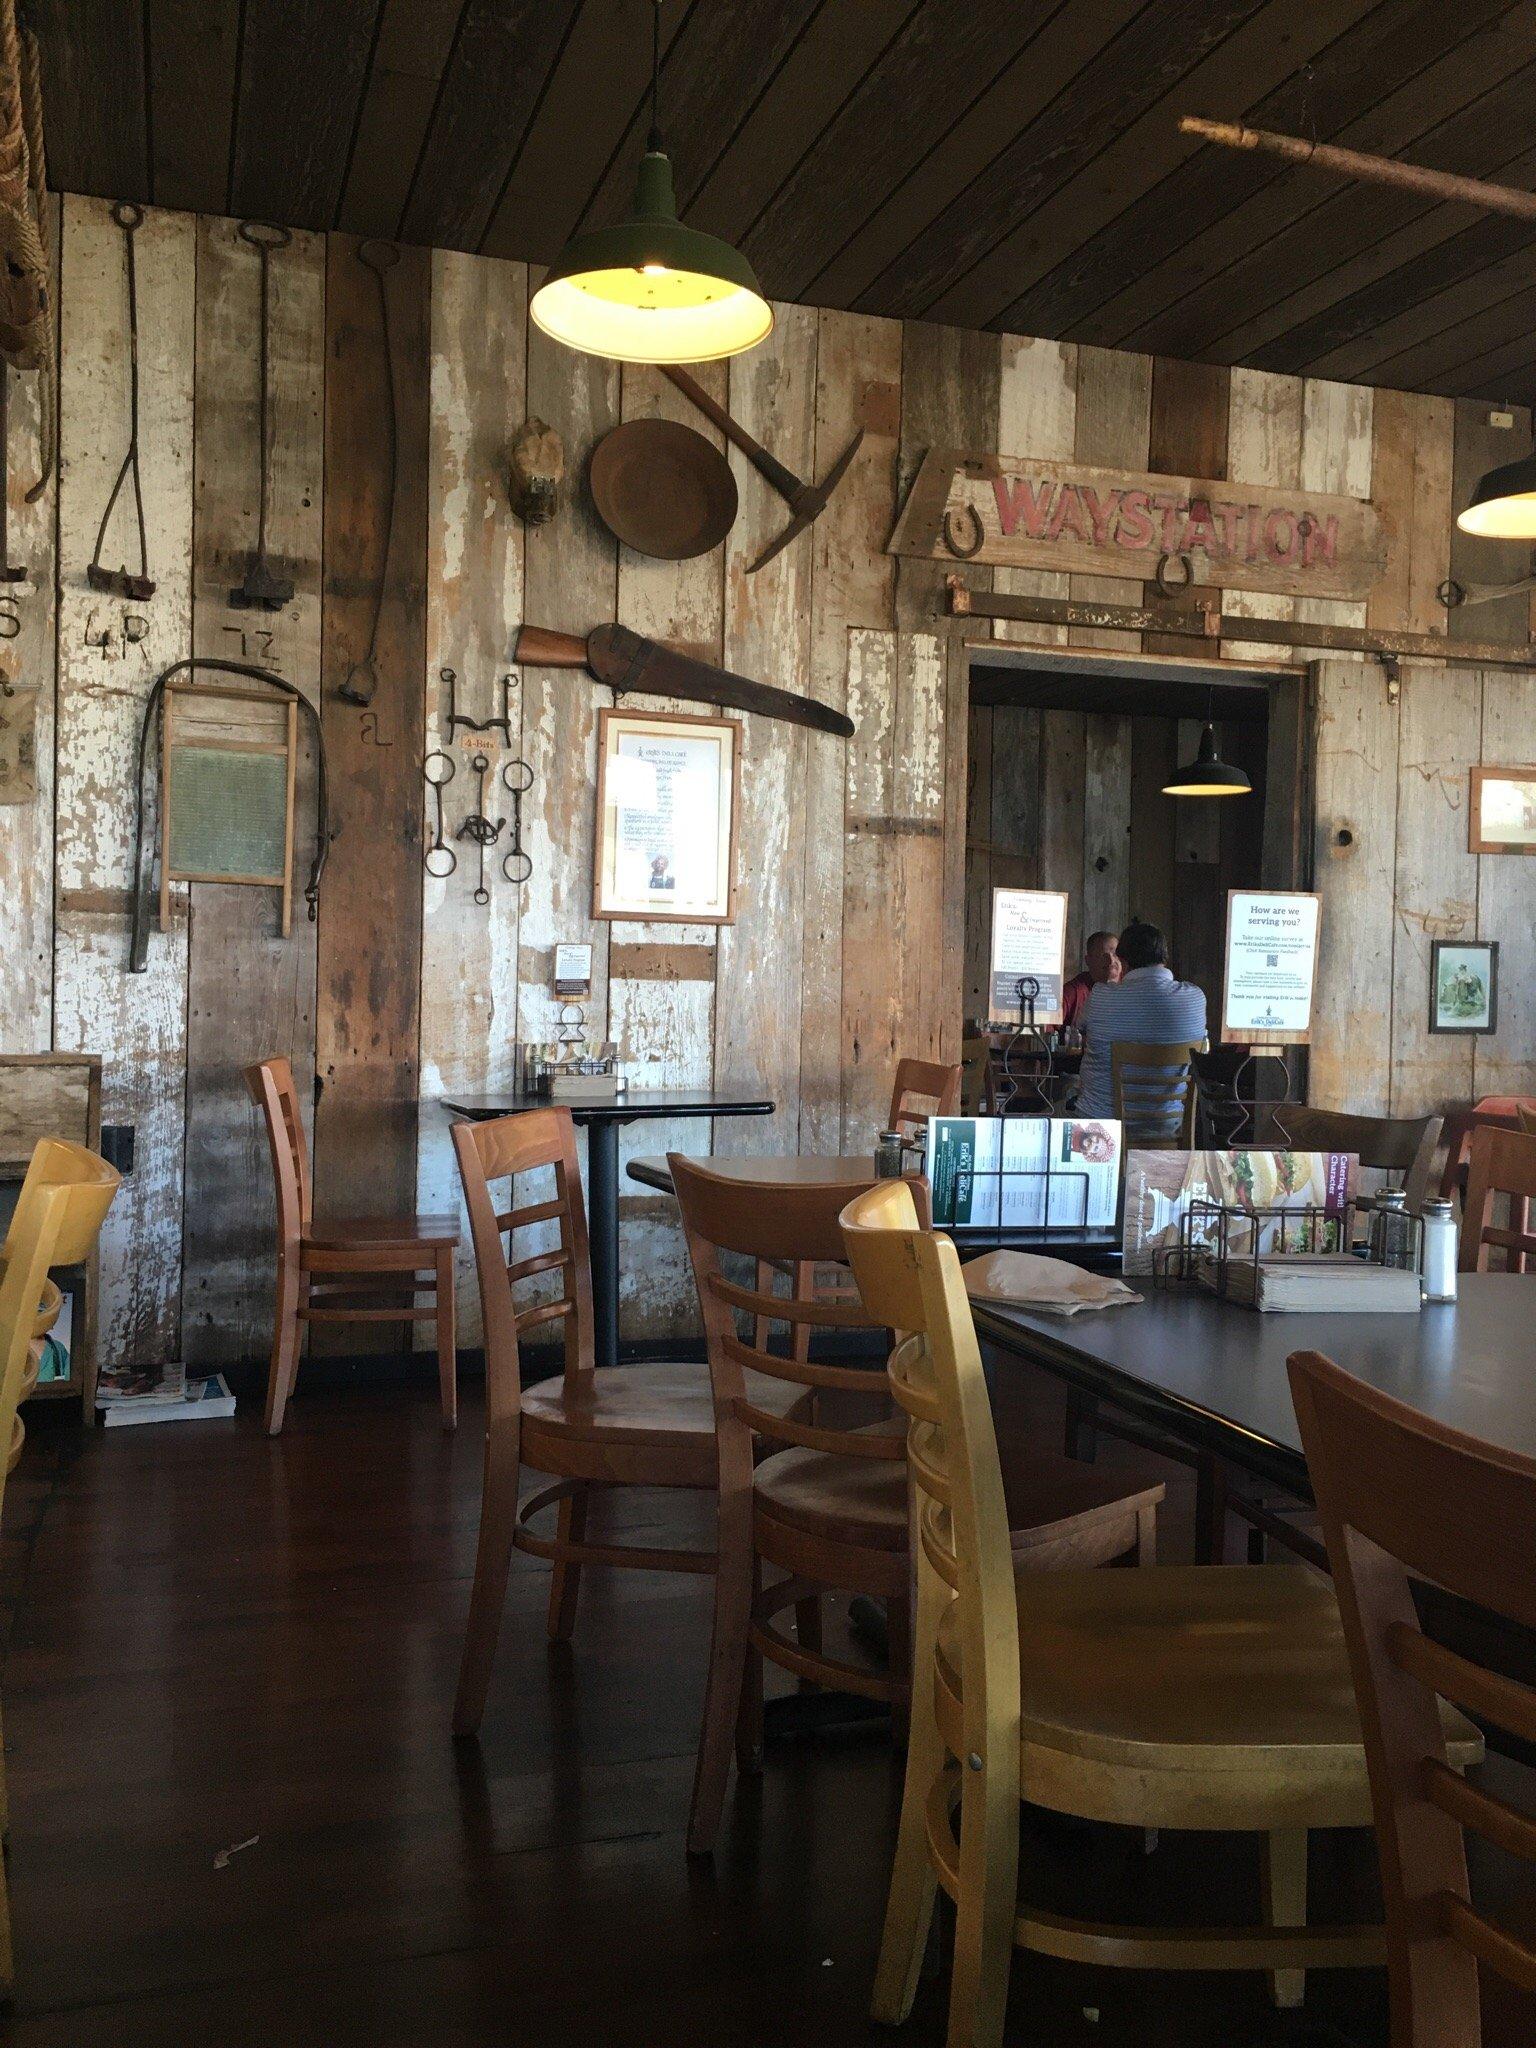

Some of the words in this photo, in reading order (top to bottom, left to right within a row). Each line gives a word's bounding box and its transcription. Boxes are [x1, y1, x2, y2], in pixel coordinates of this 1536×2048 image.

[992, 475, 1340, 568] WAYSTATION
[1248, 917, 1280, 927] serving
[1281, 918, 1301, 927] you?
[1250, 905, 1271, 914] How
[1329, 1155, 1338, 1195] Character
[1338, 1155, 1348, 1190] Catering
